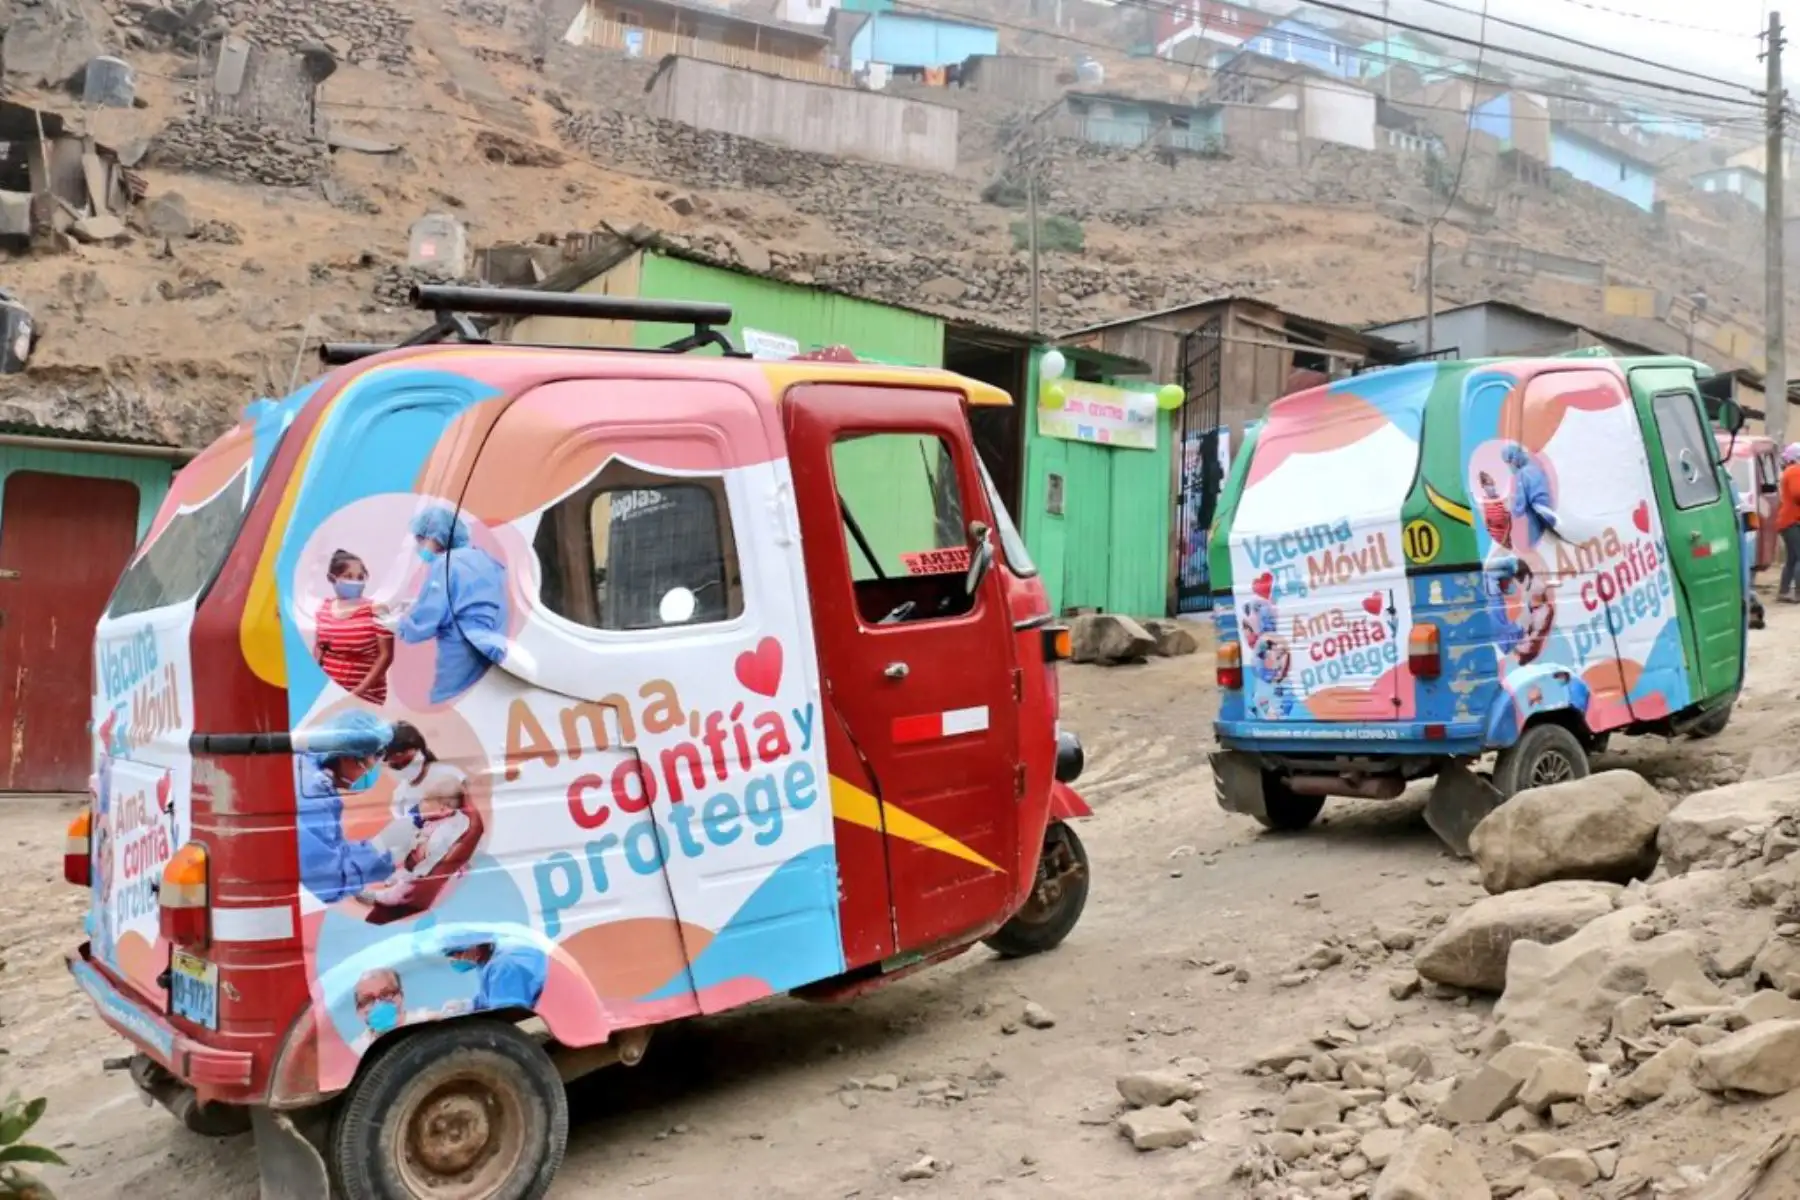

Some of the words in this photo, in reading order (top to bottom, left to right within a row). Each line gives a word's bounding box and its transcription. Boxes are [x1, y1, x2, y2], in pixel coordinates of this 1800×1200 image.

[1243, 519, 1352, 569] Vacuna
[1306, 532, 1394, 590] Móvil
[1407, 525, 1433, 559] 10
[1581, 538, 1657, 612] confía
[1655, 536, 1666, 563] y
[1309, 616, 1386, 662] confía
[1573, 569, 1670, 665] protege
[101, 623, 158, 701] Vacuna
[1301, 641, 1398, 694] protege
[131, 662, 182, 752] Móvil
[505, 679, 700, 781] Ama,
[567, 701, 791, 829] confía
[793, 702, 814, 750] y
[533, 761, 817, 938] protege
